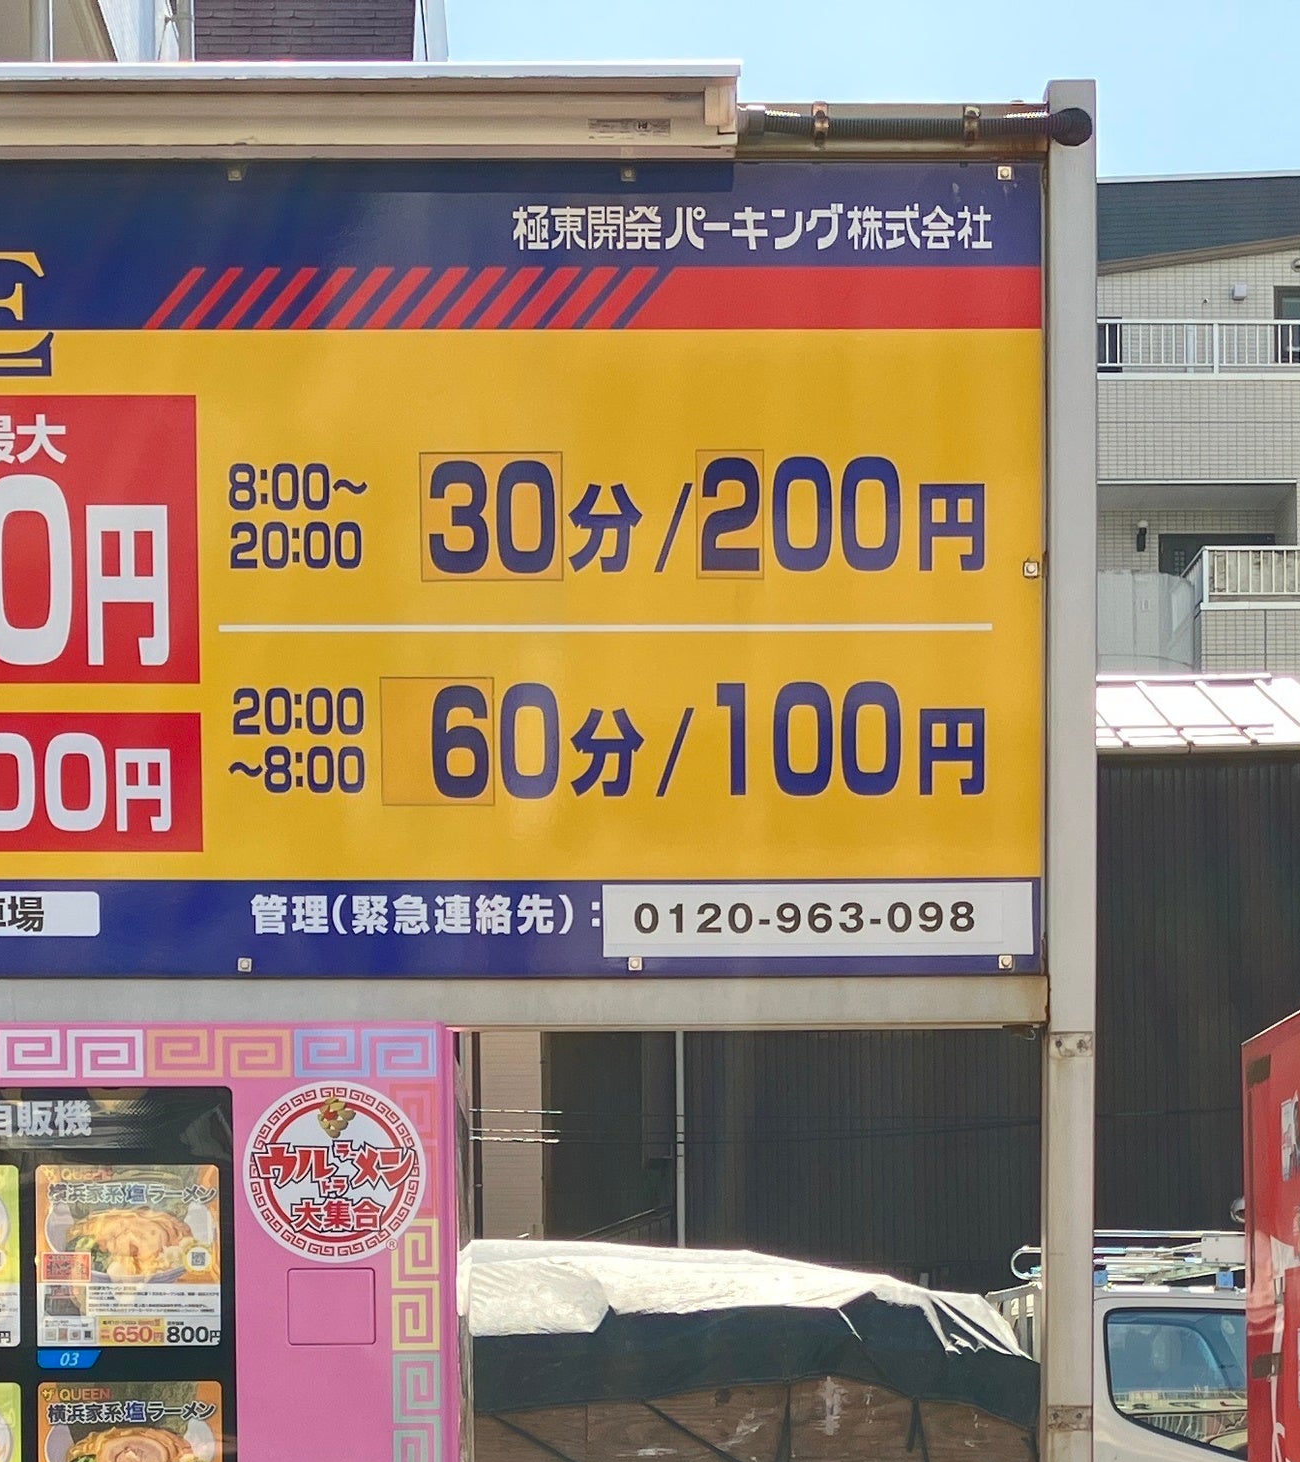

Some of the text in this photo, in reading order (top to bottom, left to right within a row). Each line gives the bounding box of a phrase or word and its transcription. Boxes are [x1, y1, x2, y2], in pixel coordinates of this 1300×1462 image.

[512, 204, 993, 252] 極東開発パーキング株式会社
[230, 522, 362, 570] 20:00
[232, 687, 365, 736] 20:00
[633, 901, 977, 935] 0120-963-098
[48, 1184, 217, 1204] 横浜家系塩ラーメン
[291, 1199, 385, 1232] 大集合
[113, 1325, 220, 1343] 650円 800円
[59, 1352, 80, 1366] 03
[59, 1388, 111, 1400] QUEEN
[47, 1402, 217, 1424] 横浜家系塩ラーメン
